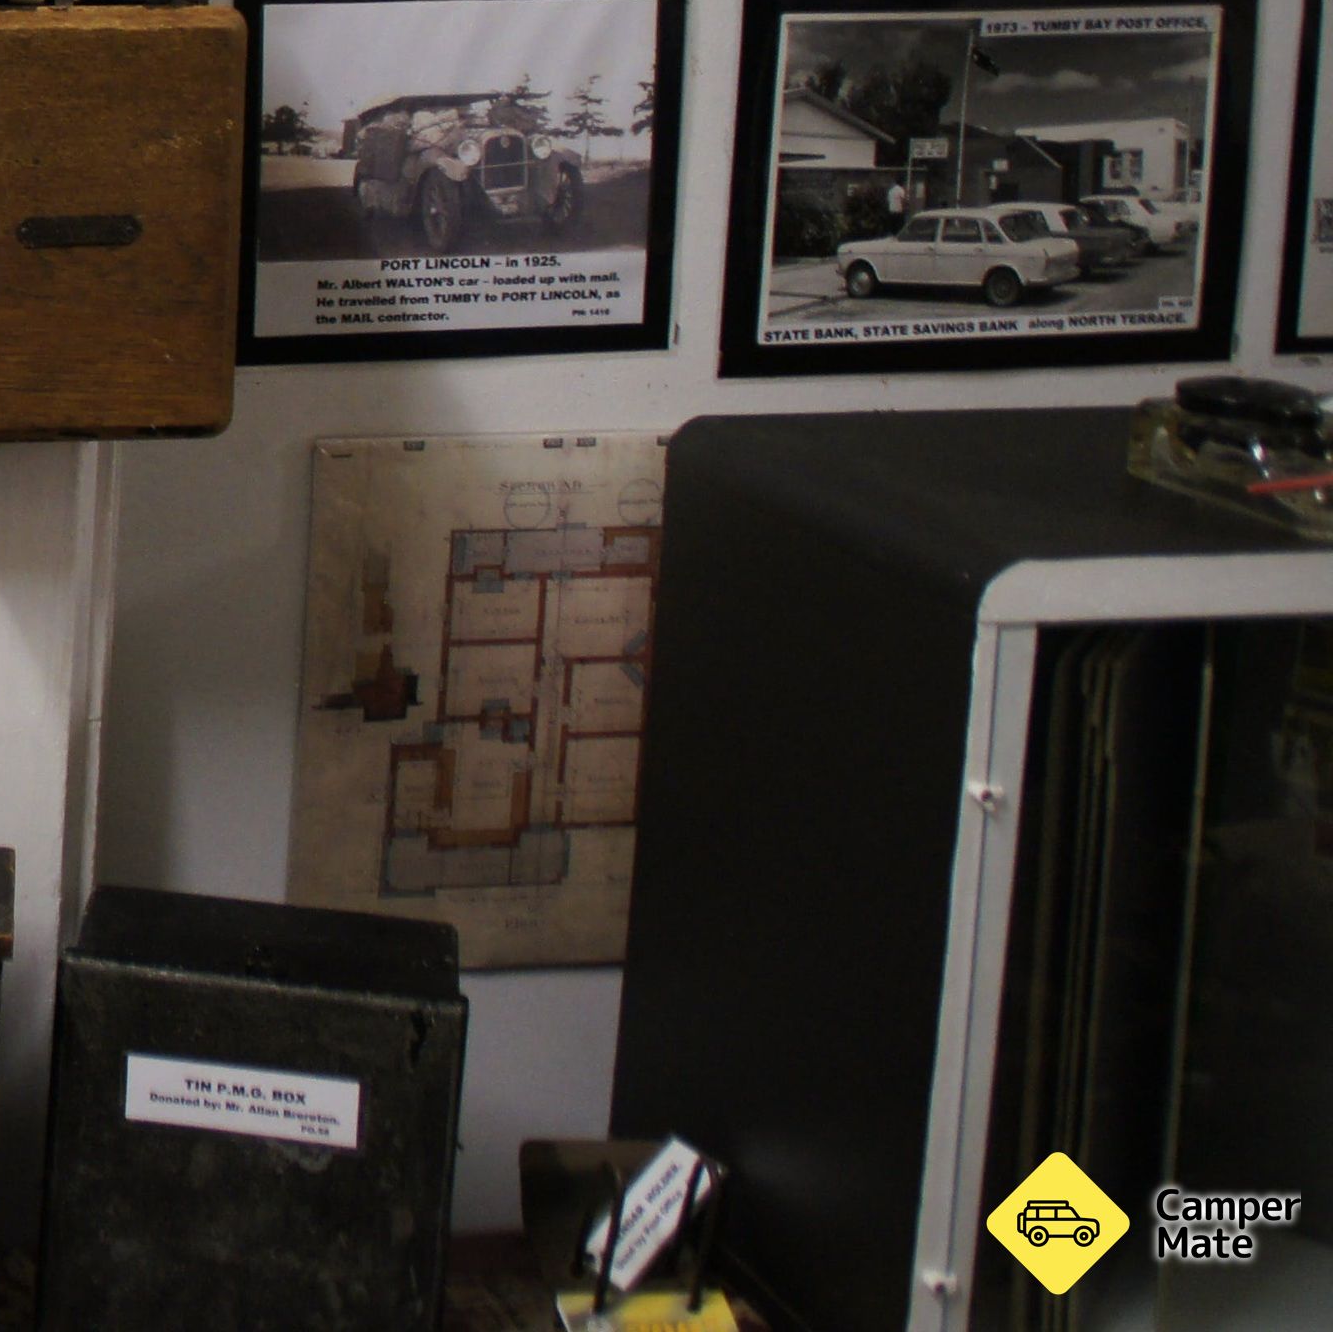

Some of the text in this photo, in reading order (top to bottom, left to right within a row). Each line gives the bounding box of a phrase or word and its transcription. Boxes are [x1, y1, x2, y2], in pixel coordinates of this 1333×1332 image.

[381, 259, 420, 270] PORT
[425, 258, 491, 270] LINCOLN
[506, 257, 518, 268] in
[524, 256, 561, 268] 1925.
[764, 312, 1187, 342] STATE BANK, STATE SAVINGS BANK along NORTH TERRACE.
[184, 1078, 306, 1105] TIN P.M.G. BOX
